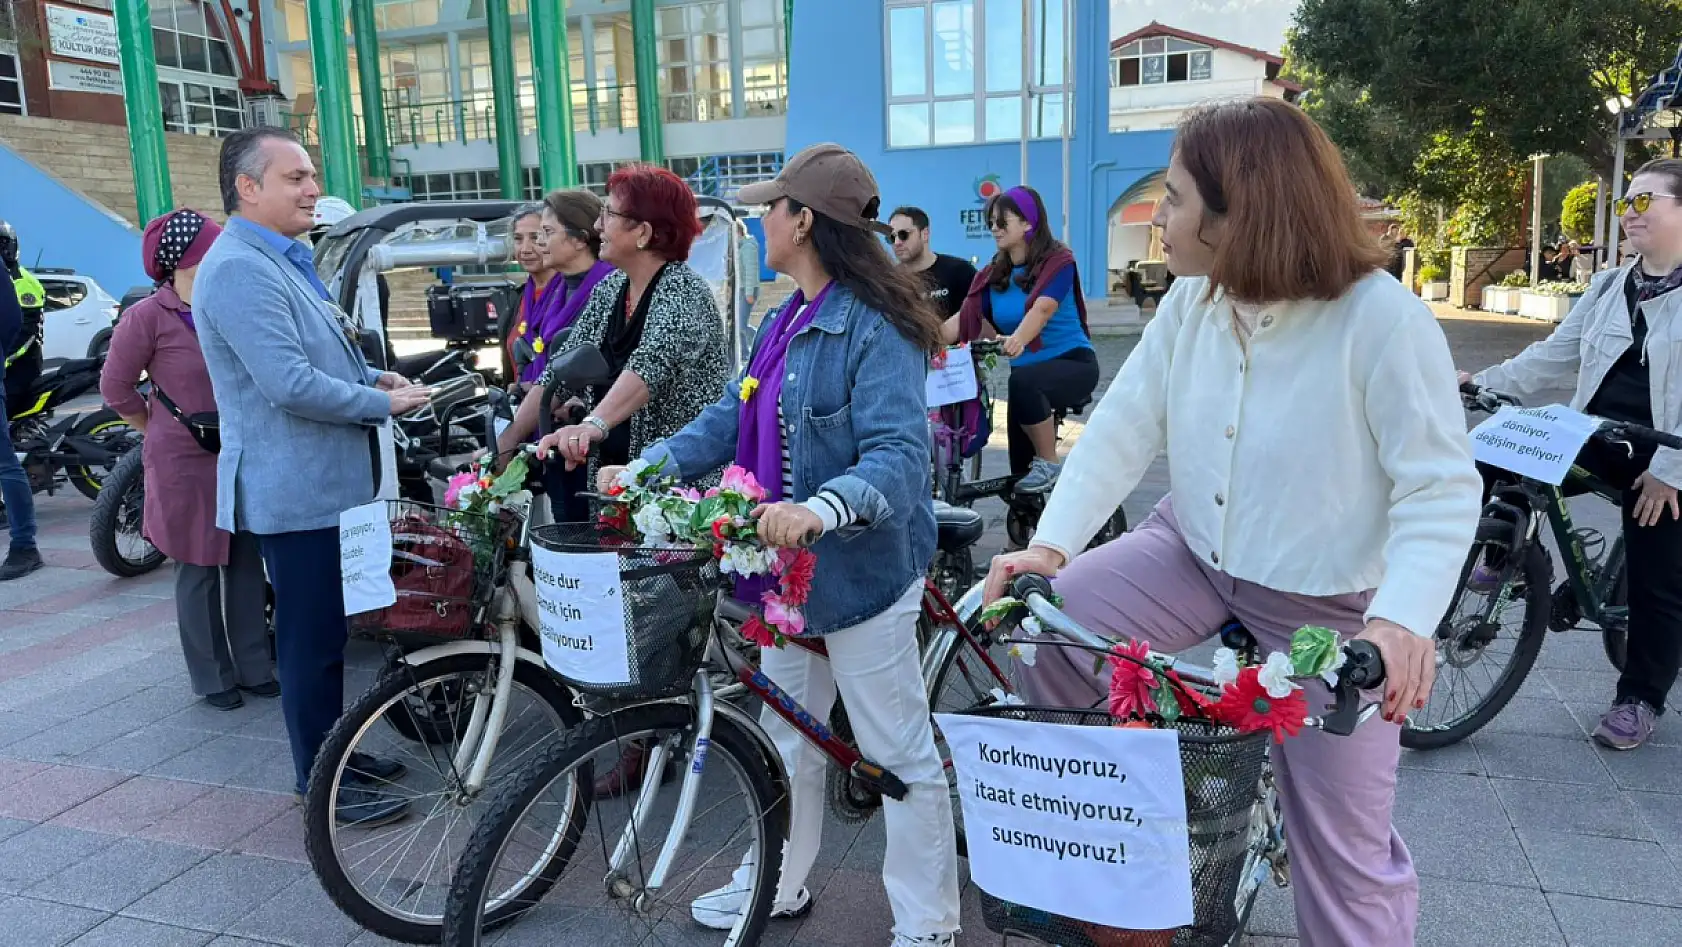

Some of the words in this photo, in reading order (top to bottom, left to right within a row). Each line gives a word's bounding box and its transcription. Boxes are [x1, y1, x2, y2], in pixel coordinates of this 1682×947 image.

[1475, 431, 1518, 451] değişim
[1517, 445, 1564, 464] geliyor!
[1502, 421, 1551, 442] dönüyor,
[557, 573, 580, 590] dur
[559, 601, 582, 622] için
[978, 742, 1127, 783] Korkmuyoruz,
[974, 779, 1016, 806] itaat
[1021, 792, 1143, 827] etmiyoruz,
[992, 826, 1127, 864] susmuyoruz!
